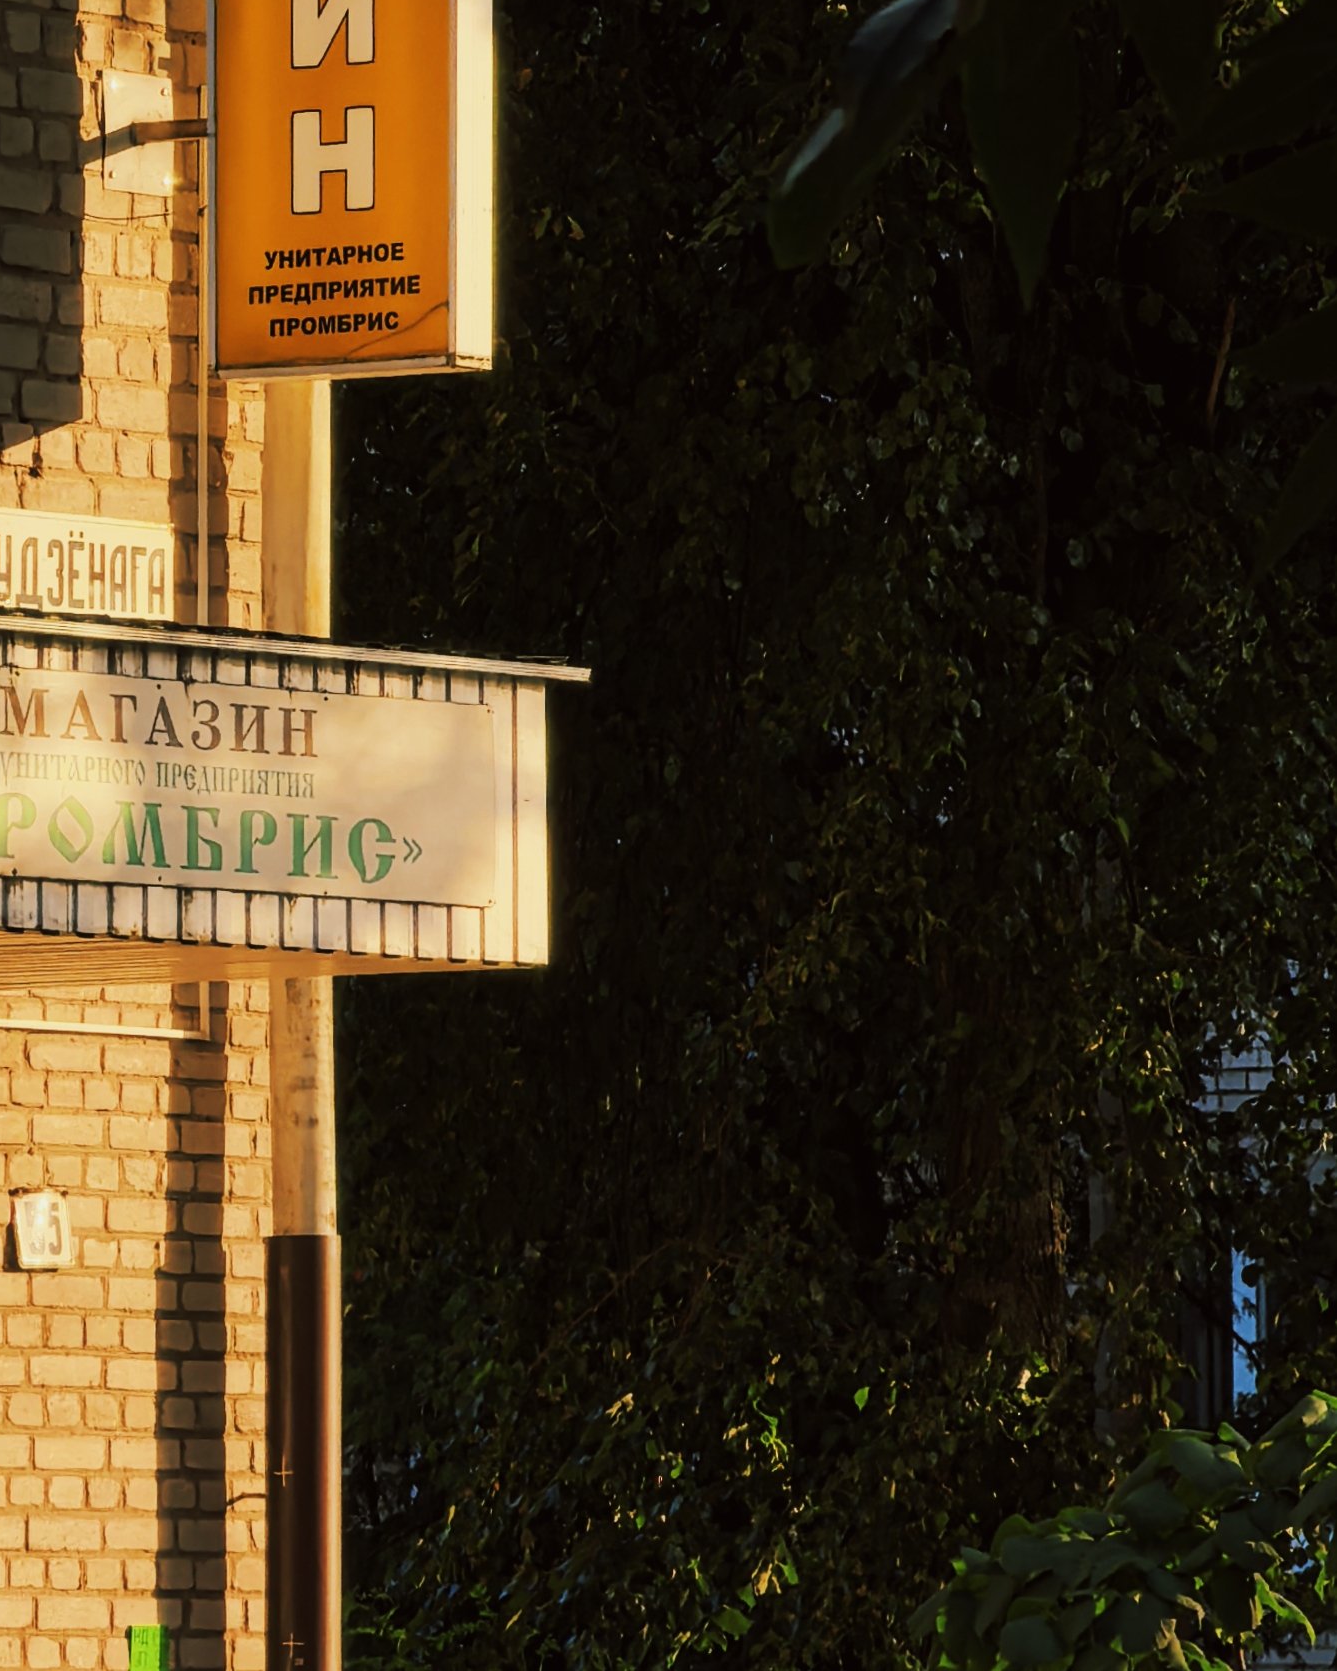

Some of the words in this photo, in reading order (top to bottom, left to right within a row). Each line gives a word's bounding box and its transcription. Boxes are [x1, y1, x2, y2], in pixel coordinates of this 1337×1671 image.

[265, 242, 404, 270] УНИТАРНОЕ
[249, 275, 420, 305] ПРЕДПРИЯТИЕ
[269, 311, 399, 338] ПРОМБРИС
[0, 685, 318, 757] МАГАЗИН
[0, 750, 146, 787] УНИТАРНОГО
[157, 761, 316, 799] ПРЕДПРИЯТИЯ
